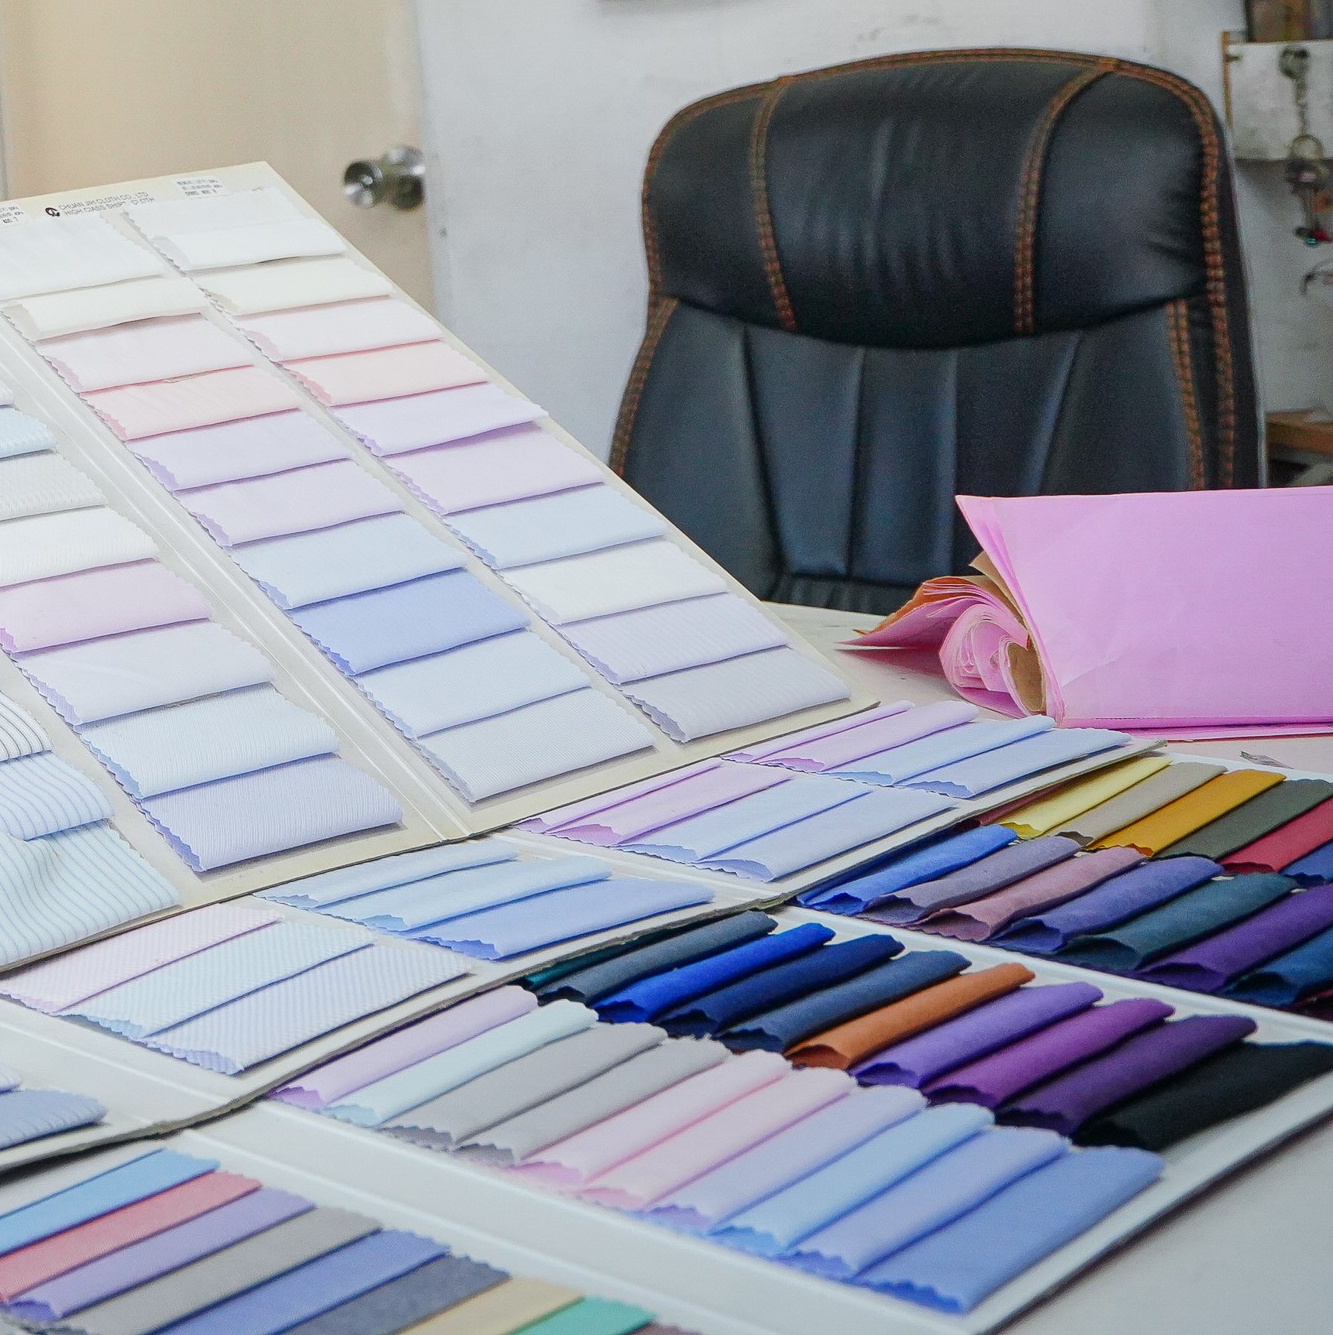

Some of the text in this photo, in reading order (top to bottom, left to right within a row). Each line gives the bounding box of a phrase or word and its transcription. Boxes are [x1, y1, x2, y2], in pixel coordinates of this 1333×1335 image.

[59, 202, 83, 212] CHUAN
[96, 196, 119, 206] CLOTH
[64, 207, 83, 216] HIGH
